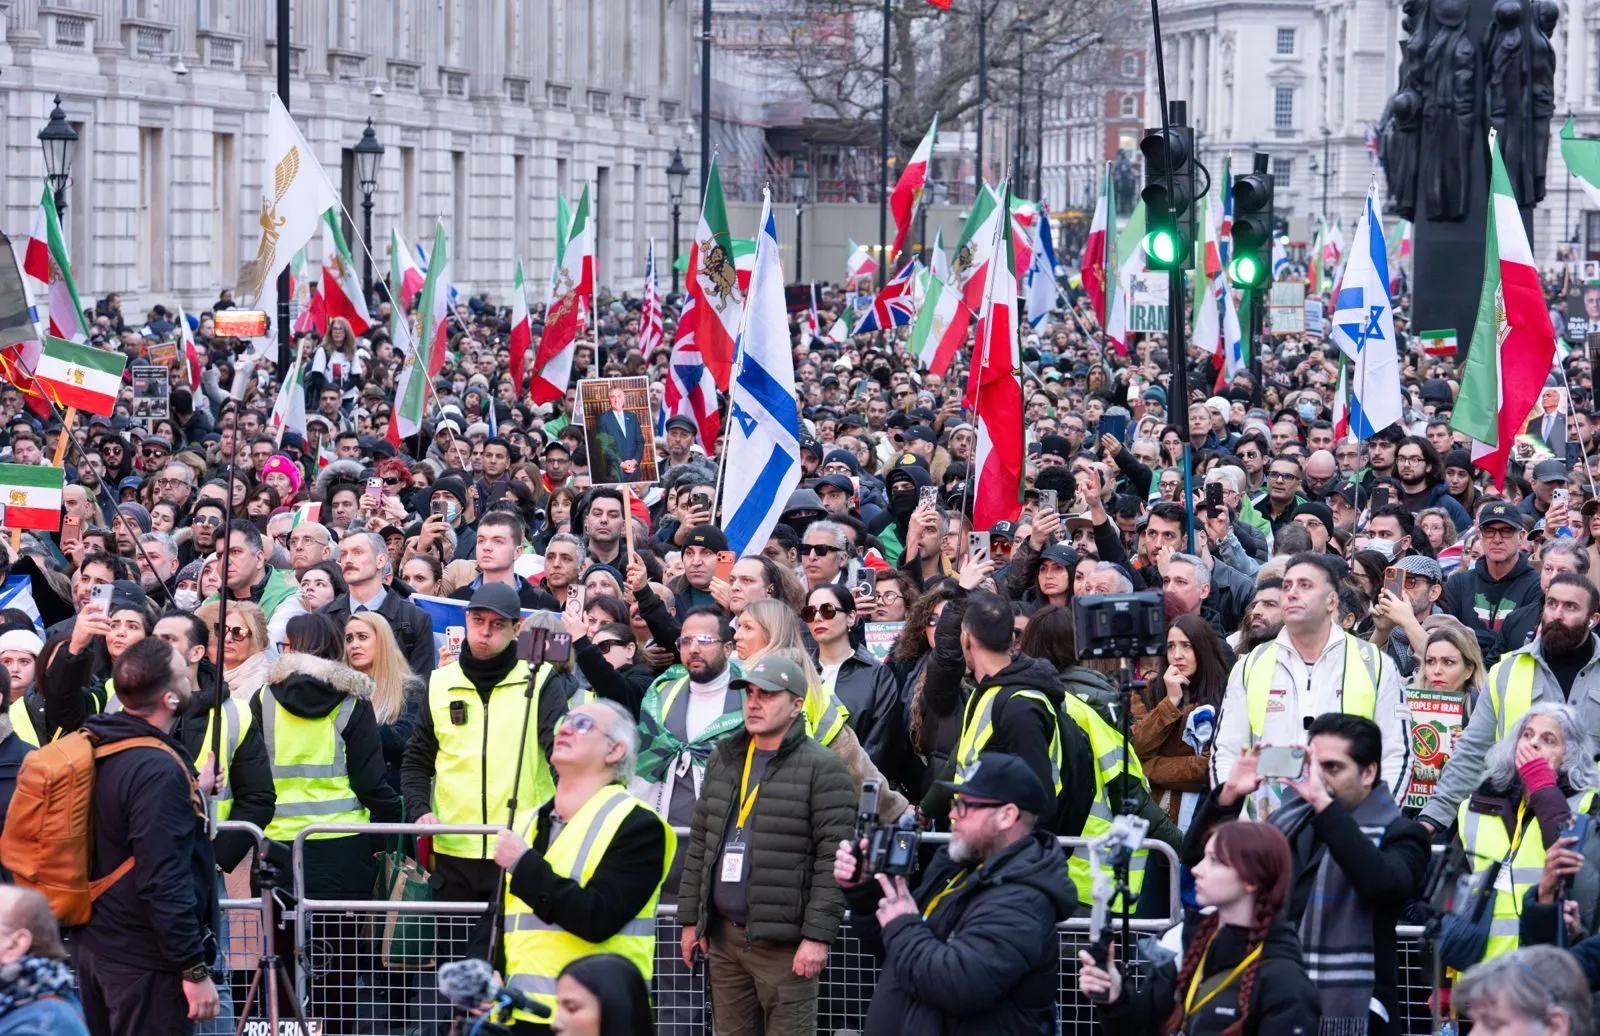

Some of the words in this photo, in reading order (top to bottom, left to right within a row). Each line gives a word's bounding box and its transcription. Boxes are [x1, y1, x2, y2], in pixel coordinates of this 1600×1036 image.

[1129, 304, 1169, 331] IRAN
[1408, 700, 1432, 710] EOPLE
[1440, 703, 1460, 713] IRAN
[1412, 783, 1428, 794] THE
